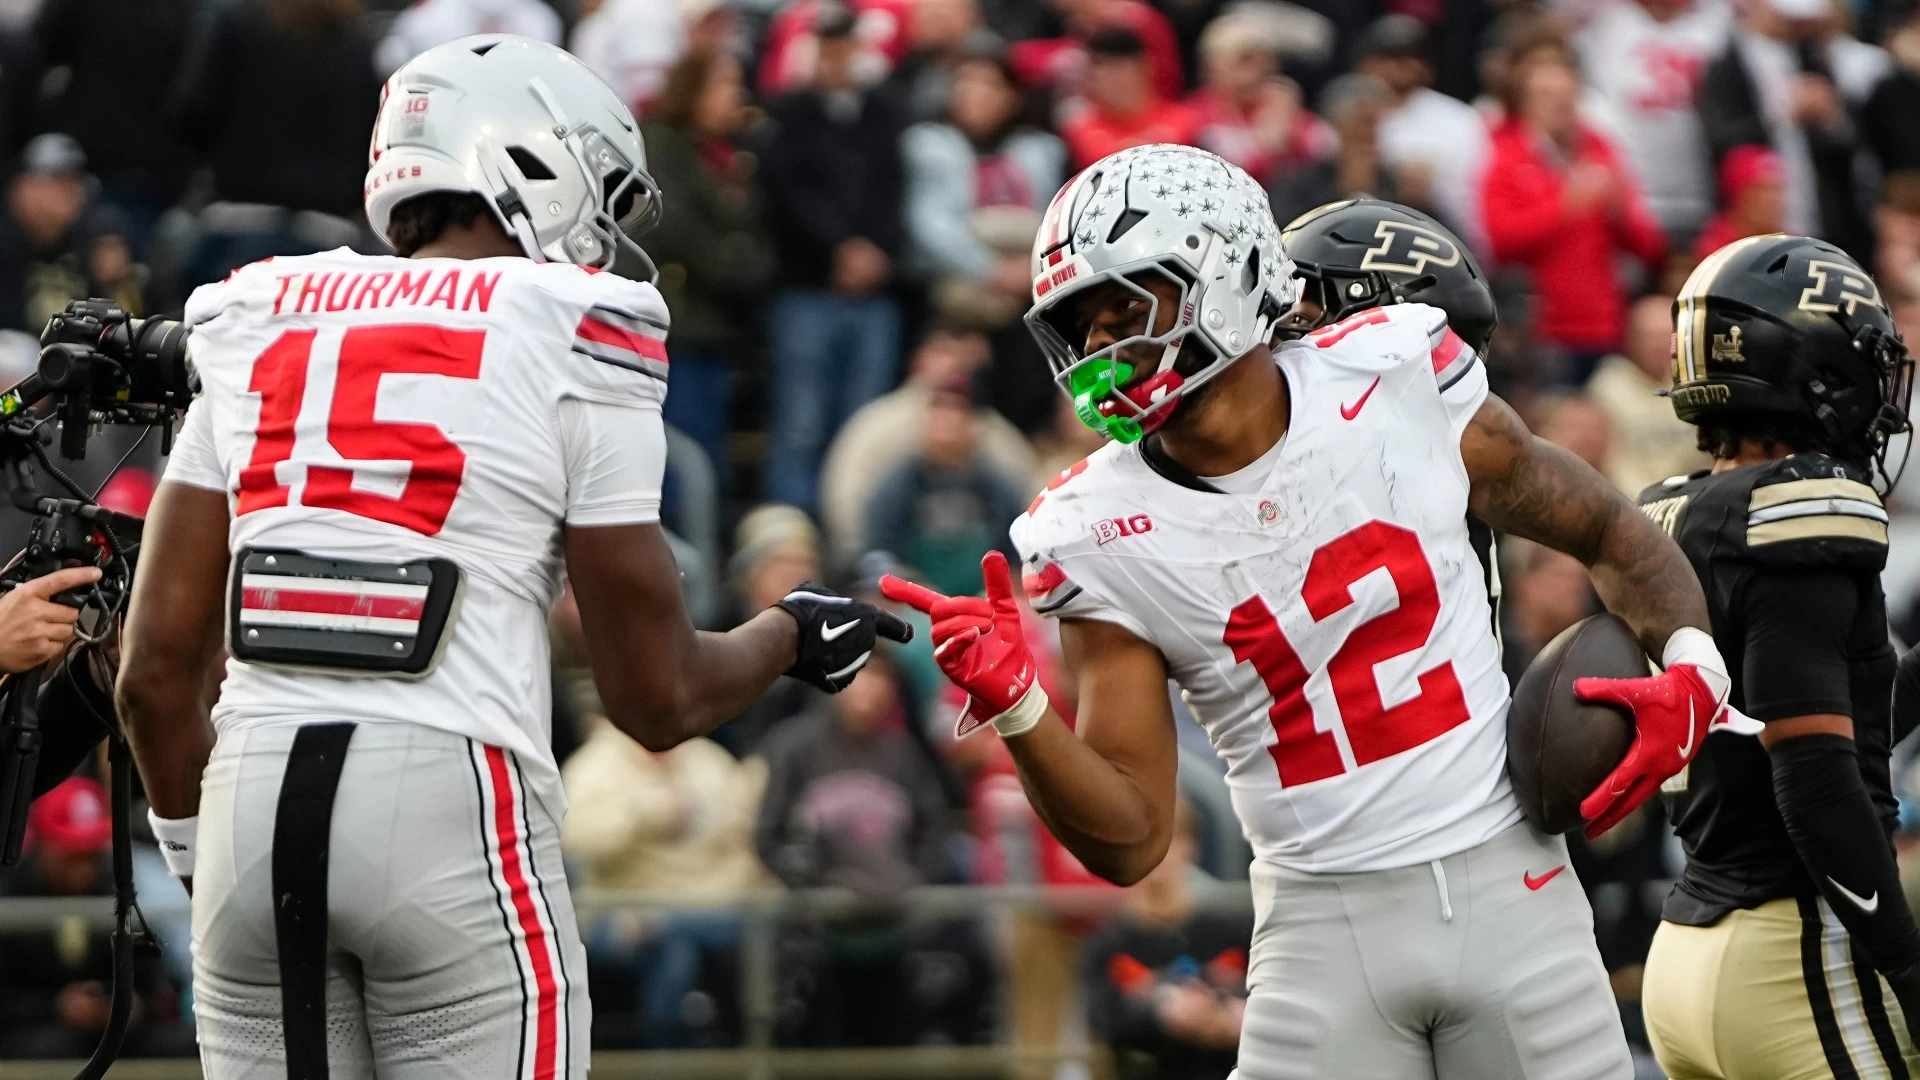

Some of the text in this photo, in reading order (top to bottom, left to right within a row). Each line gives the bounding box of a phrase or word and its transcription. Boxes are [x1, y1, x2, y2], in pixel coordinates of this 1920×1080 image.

[1052, 262, 1077, 286] STATE
[1360, 220, 1460, 275] P
[273, 269, 503, 315] THURMAN
[1798, 260, 1884, 316] P
[236, 323, 487, 537] 15
[1091, 513, 1153, 546] BIG
[1223, 519, 1471, 789] 12
